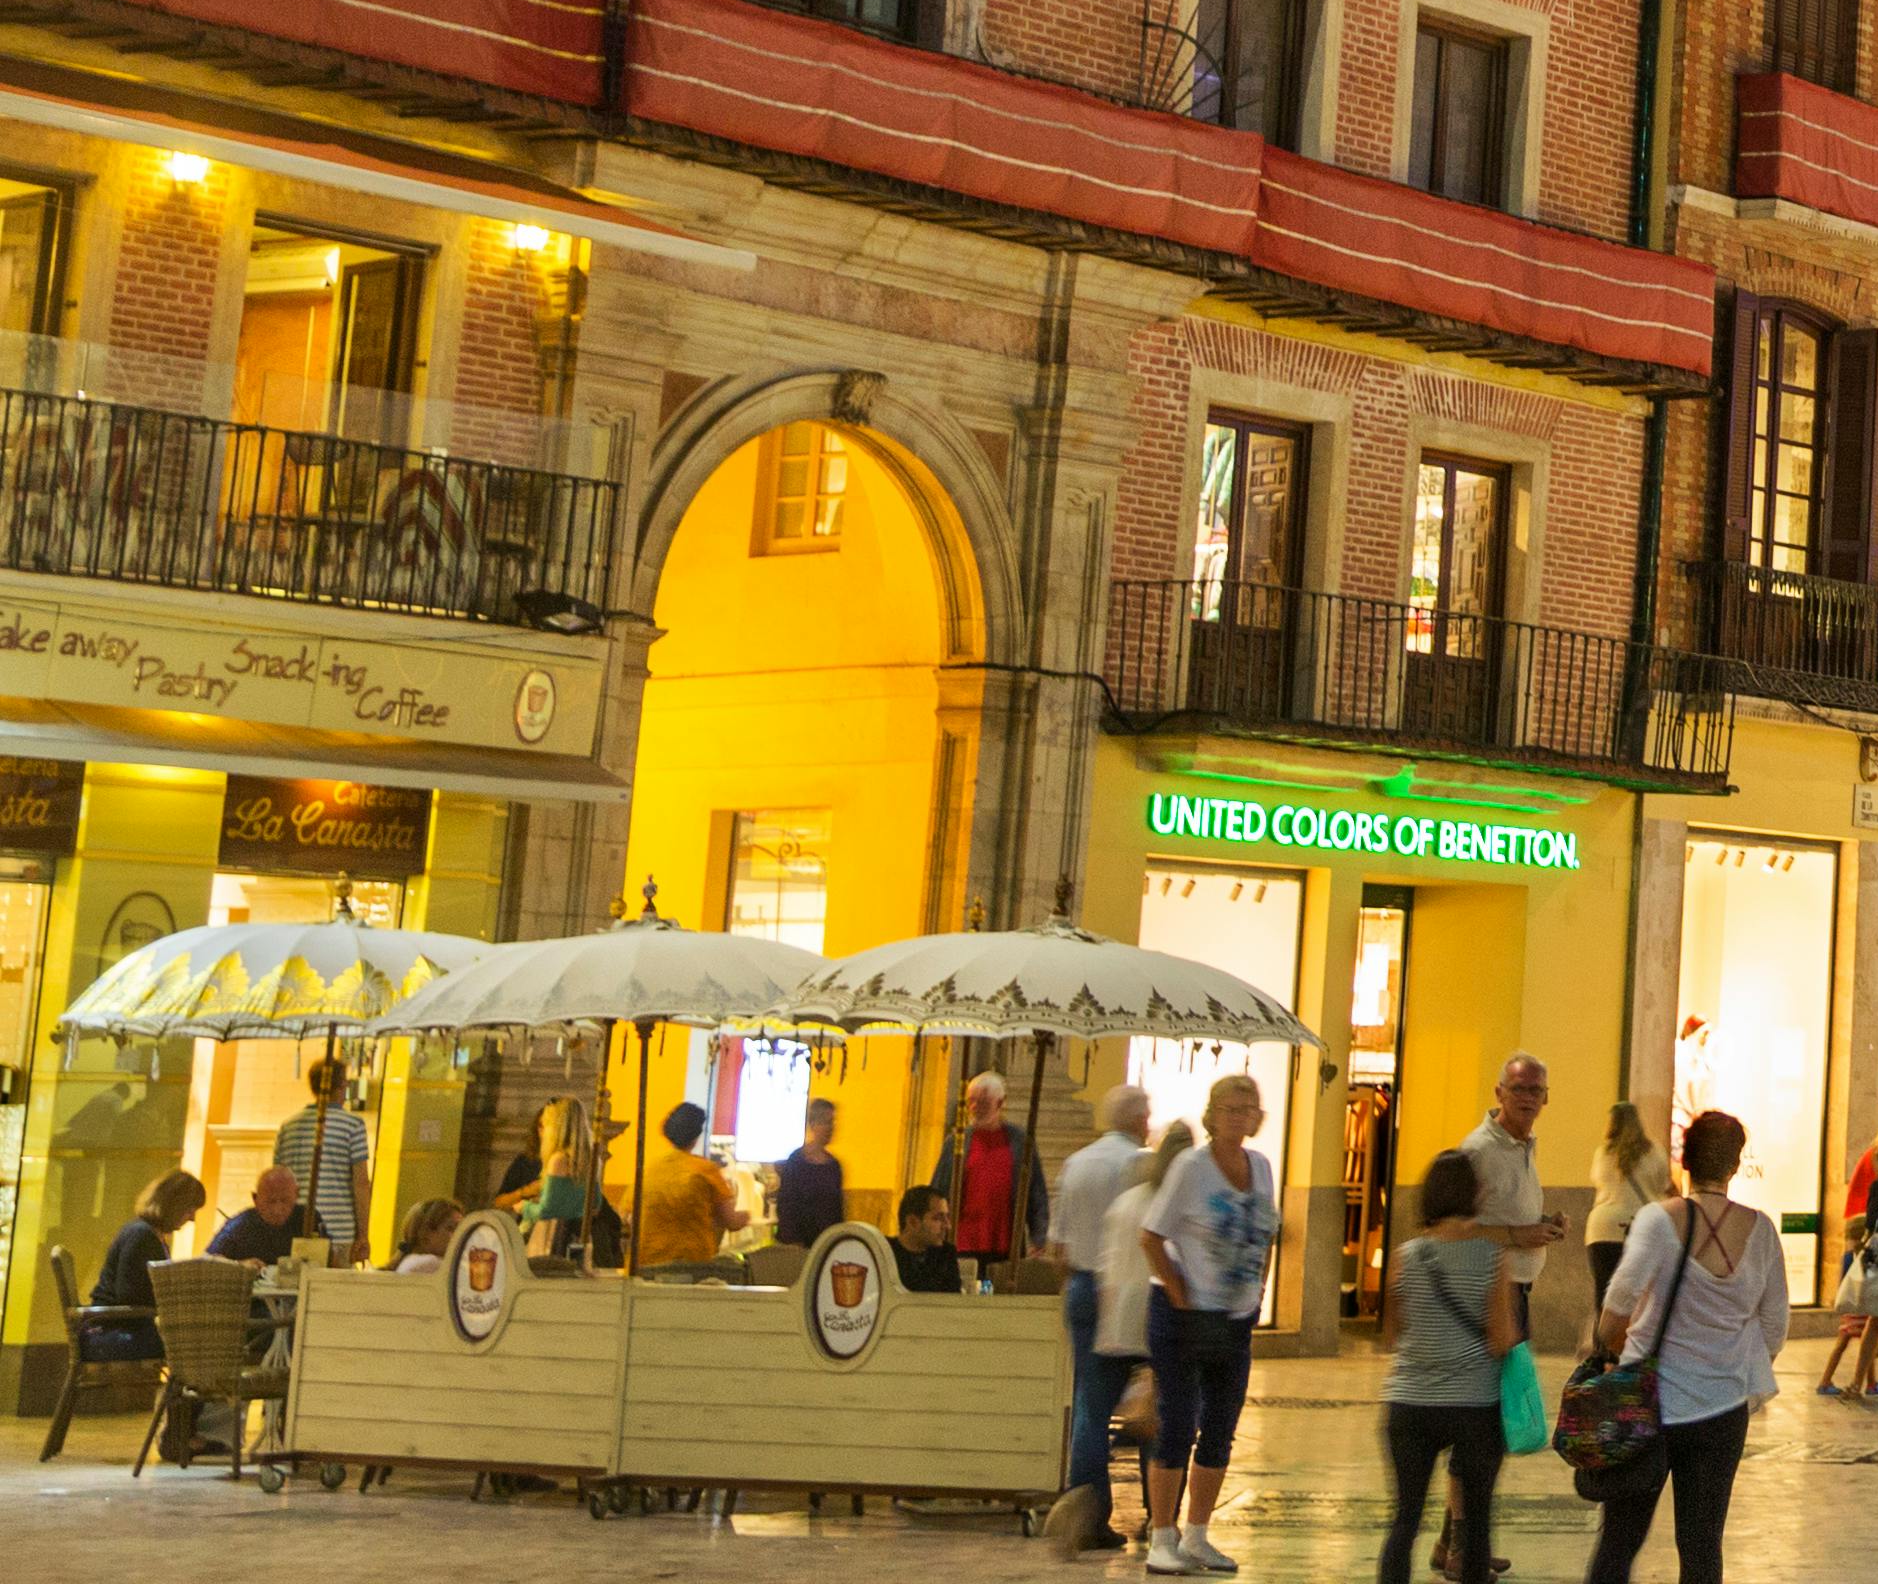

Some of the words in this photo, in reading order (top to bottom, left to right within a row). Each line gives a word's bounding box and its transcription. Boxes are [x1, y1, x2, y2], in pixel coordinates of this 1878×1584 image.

[0, 611, 51, 654] ake
[59, 629, 140, 668] away
[131, 655, 239, 708] Pastry
[354, 686, 450, 728] Coffee
[226, 796, 284, 842] La
[290, 800, 417, 851] Canasta
[1150, 792, 1267, 844] UNITED
[1271, 804, 1389, 854] COLORS
[1393, 815, 1436, 858] OF
